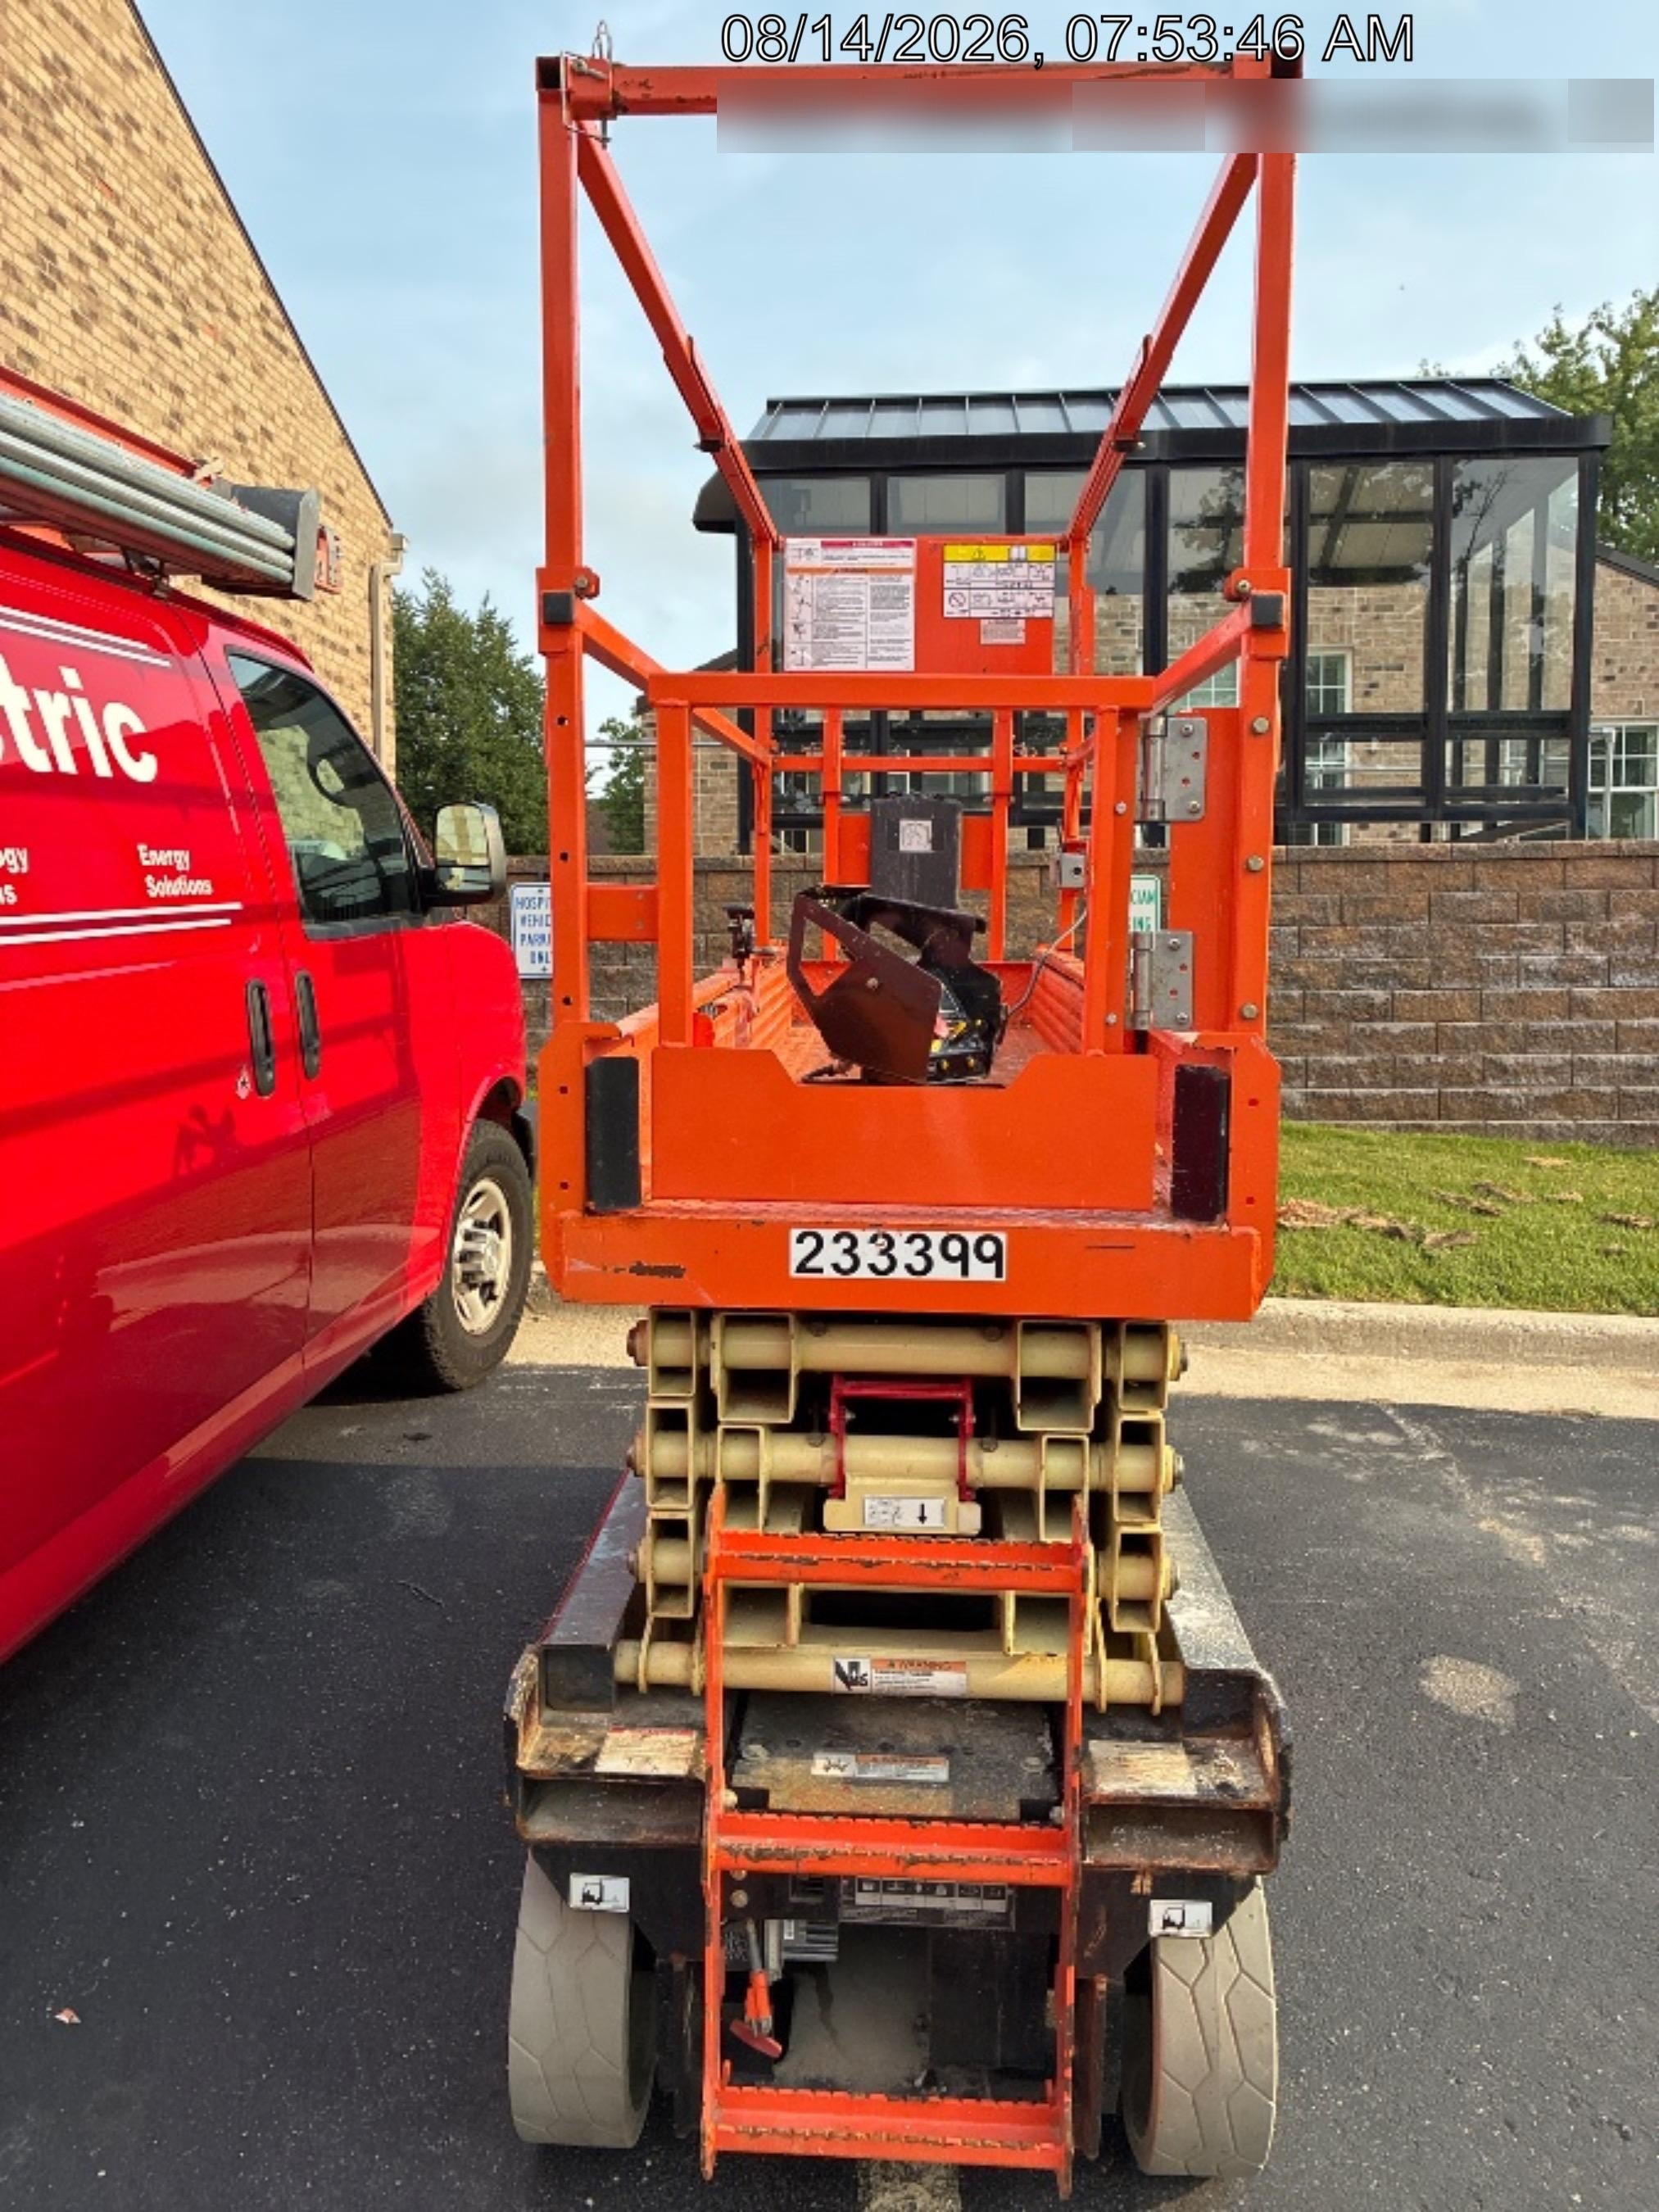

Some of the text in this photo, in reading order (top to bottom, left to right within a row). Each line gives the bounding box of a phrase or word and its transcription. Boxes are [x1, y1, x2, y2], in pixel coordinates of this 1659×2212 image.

[0, 653, 158, 783] tric
[137, 843, 191, 872] Energy
[144, 874, 214, 899] Solutions
[515, 896, 551, 910] HOSPI
[530, 950, 551, 964] ONL
[794, 1231, 1004, 1279] 233399
